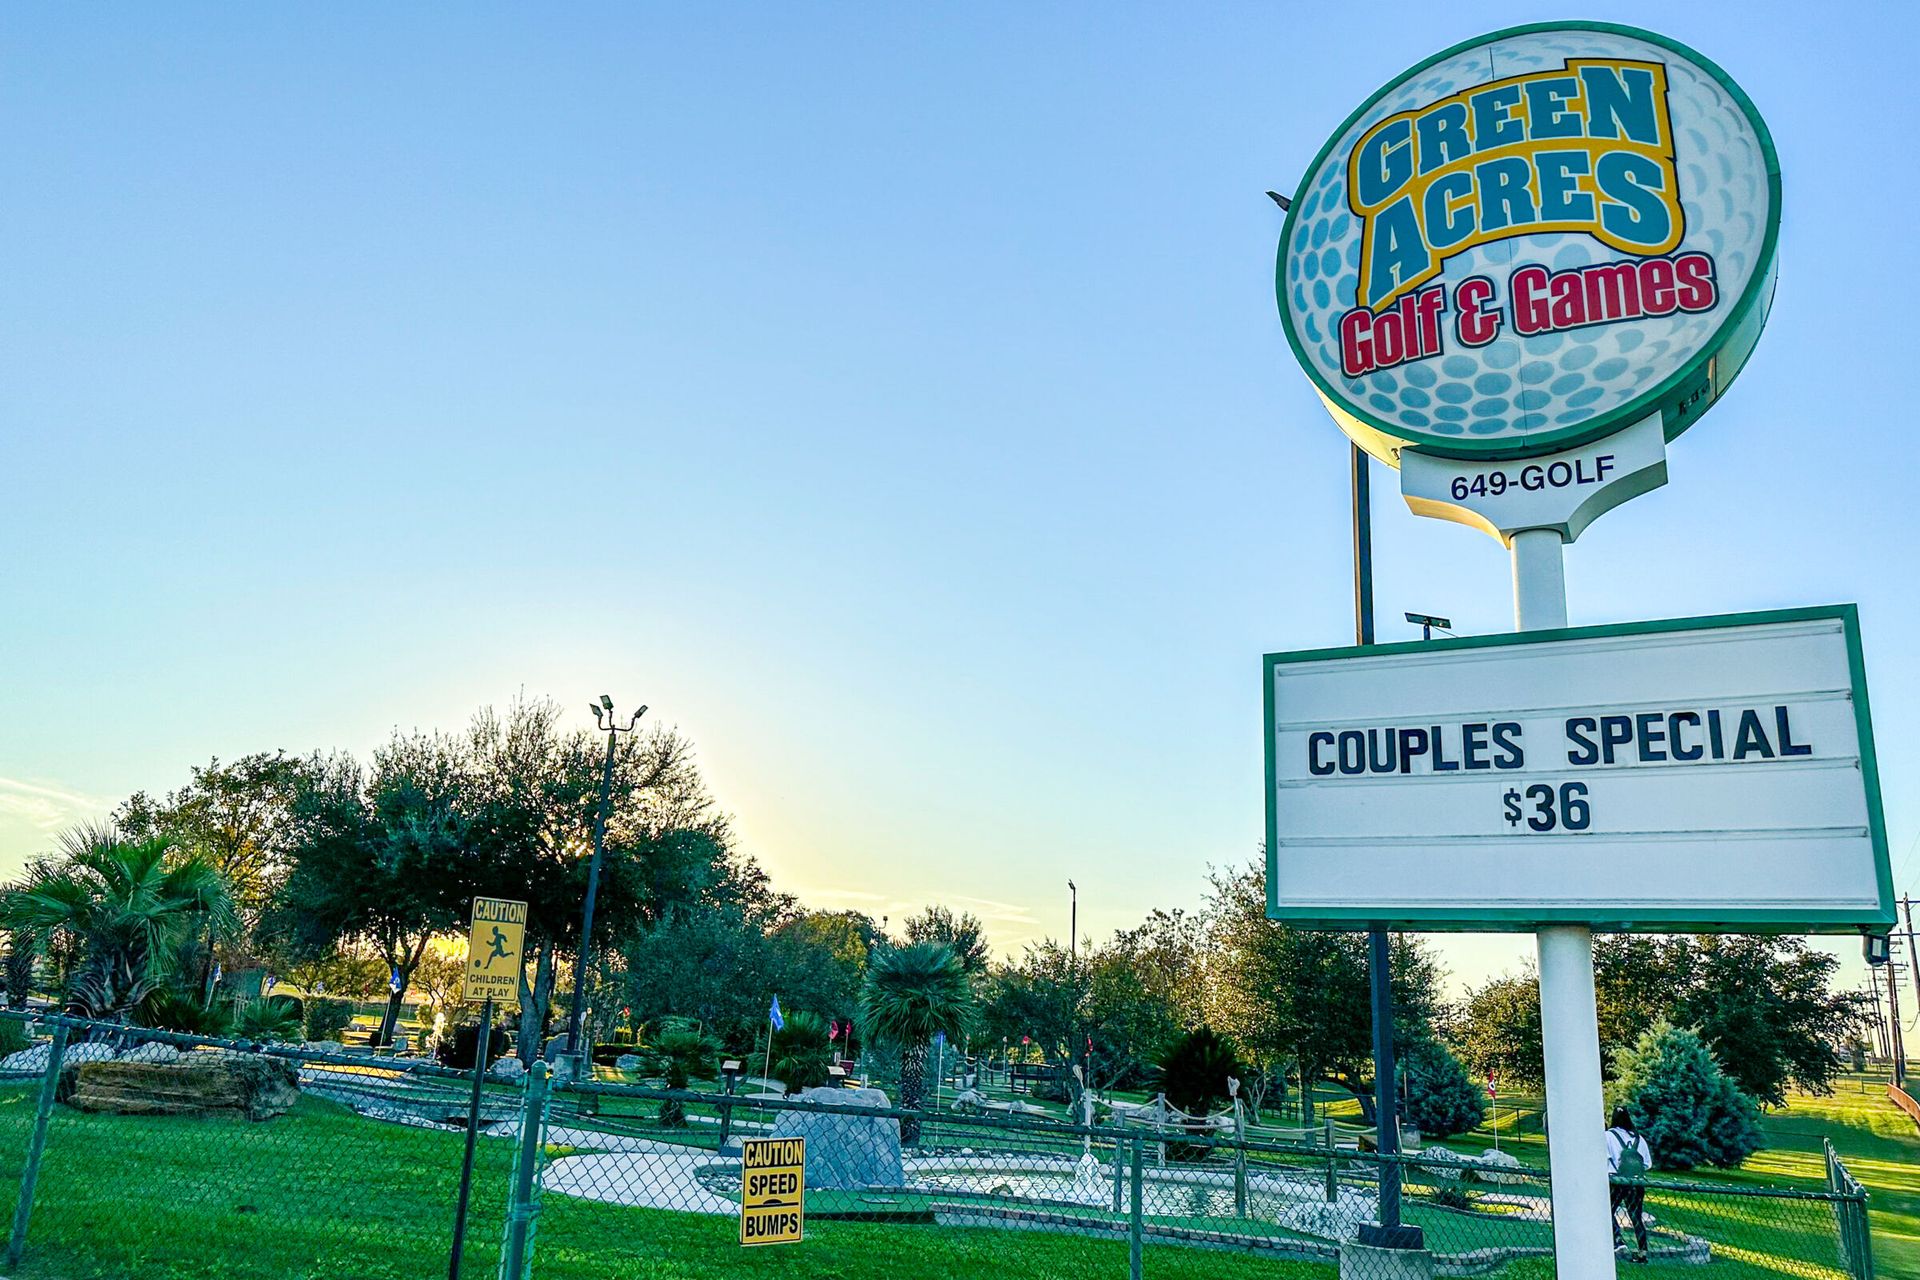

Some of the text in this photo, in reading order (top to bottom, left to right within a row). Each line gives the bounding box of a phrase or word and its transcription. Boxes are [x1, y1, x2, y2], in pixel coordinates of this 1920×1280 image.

[1358, 65, 1661, 208] GREEN
[1367, 150, 1672, 307] ACRES
[1340, 255, 1715, 376] Golf & Games
[1451, 455, 1615, 501] 649-GOLF
[1308, 705, 1812, 776] COUPLES SPECIAL
[1503, 782, 1591, 832] $36
[475, 900, 525, 923] CAUTION
[469, 974, 515, 985] CHILDREN
[472, 987, 509, 997] AT PLAY
[745, 1140, 802, 1167] CAUTION
[749, 1173, 797, 1196] SPEED
[746, 1213, 798, 1237] BUMPS
